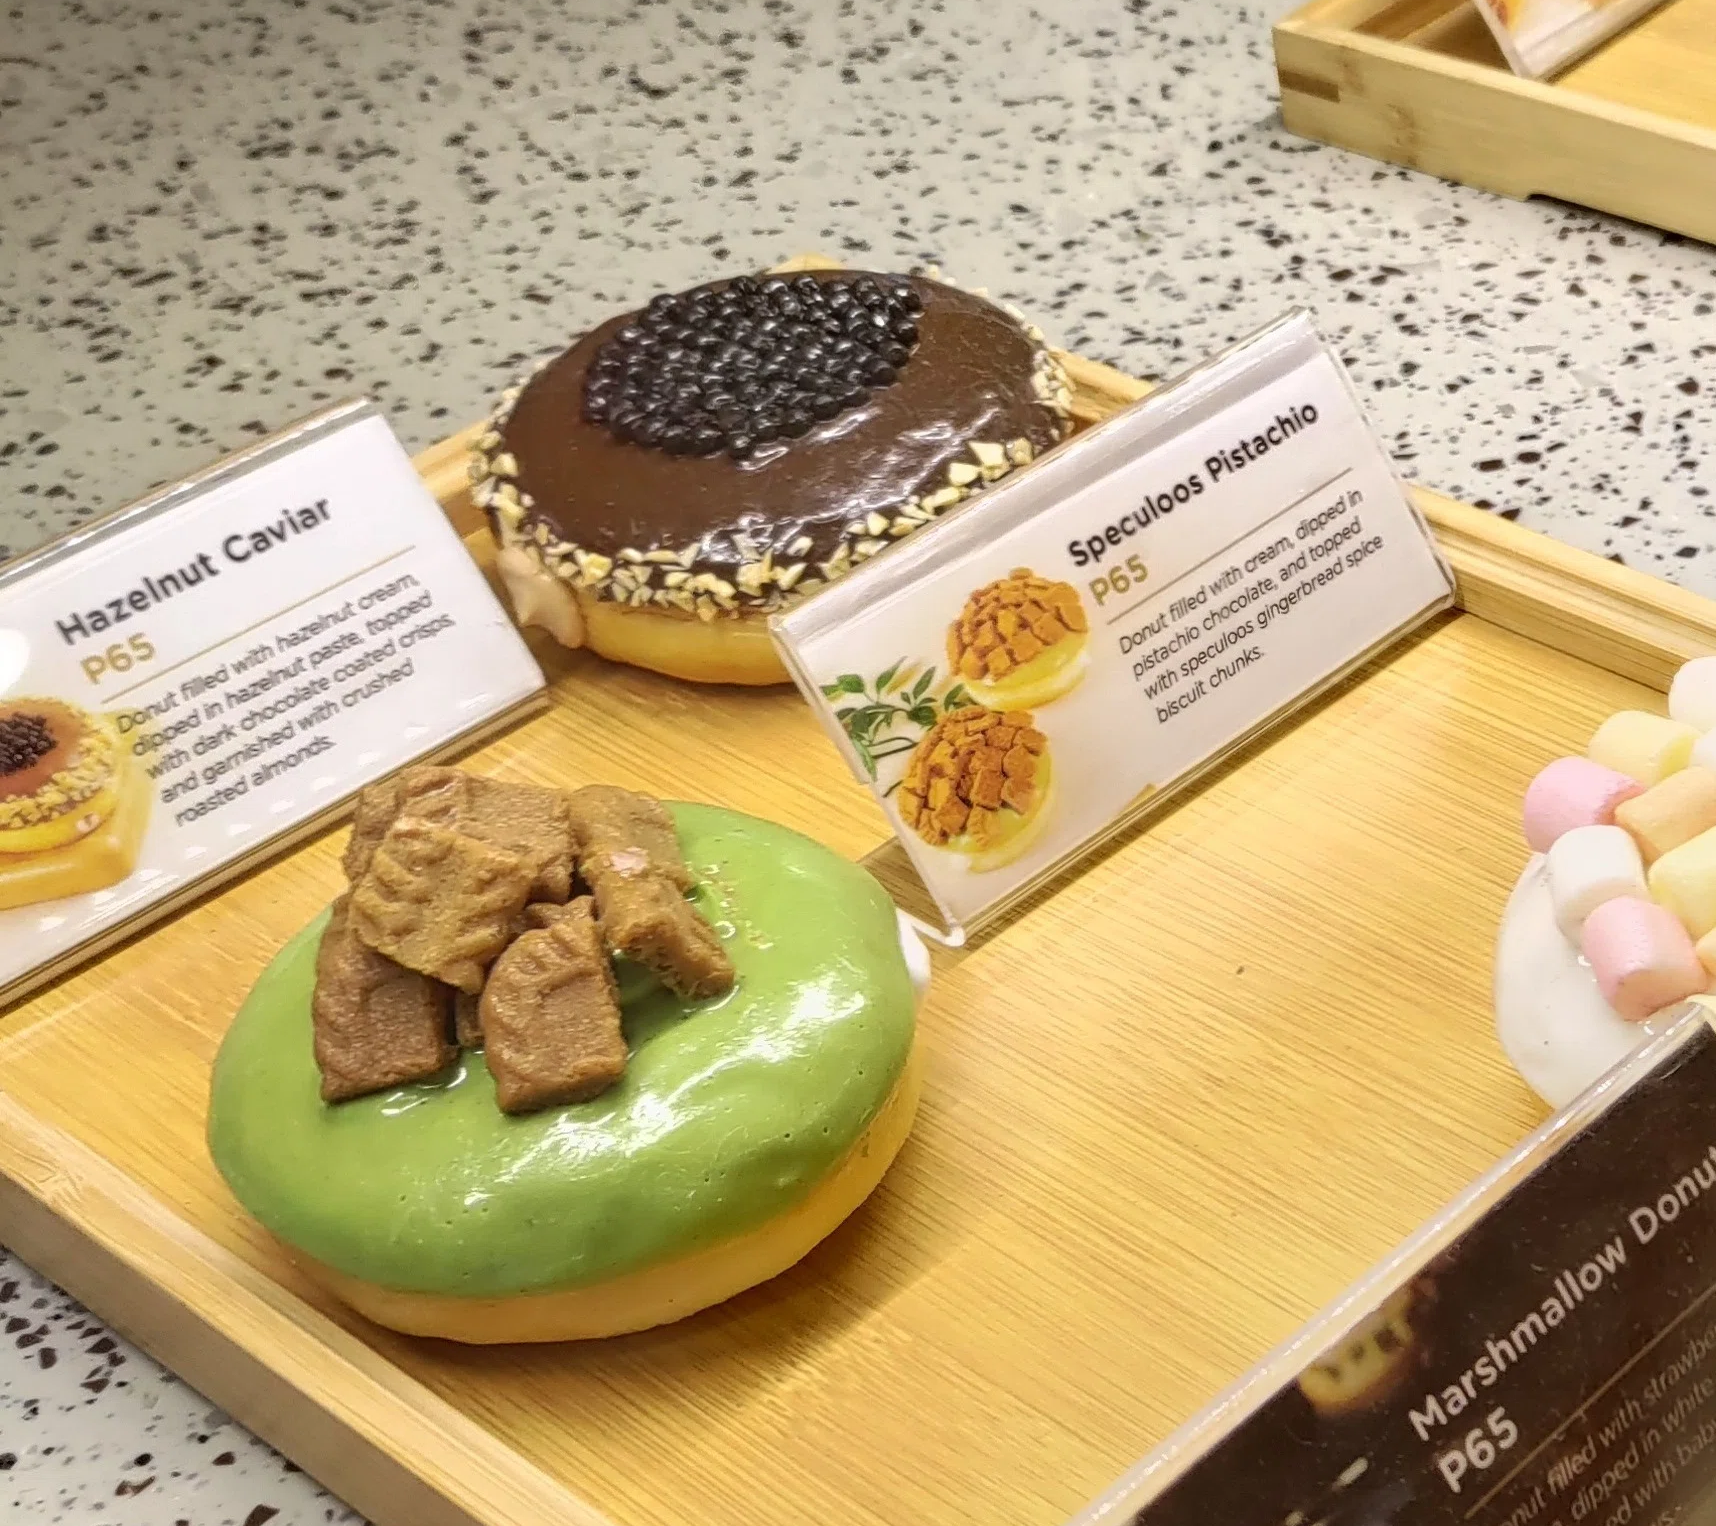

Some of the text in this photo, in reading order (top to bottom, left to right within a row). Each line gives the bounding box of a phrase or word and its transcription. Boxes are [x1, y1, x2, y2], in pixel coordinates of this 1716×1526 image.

[1067, 402, 1319, 567] Speculoos Pistachio
[55, 498, 331, 646] Hazelnut Caviar
[1088, 553, 1149, 607] P65
[1119, 488, 1363, 655] Donut filled with cream, dipped in
[1133, 517, 1362, 680] pistachio chocolate, and topped
[1143, 534, 1384, 700] with speculoos gingerbread spice
[80, 632, 156, 685] P65
[116, 690, 179, 735] Donut
[181, 663, 230, 702] filled
[231, 643, 275, 675] with
[276, 602, 356, 652] hazelnut
[132, 712, 200, 757] dipped
[203, 701, 224, 721] in
[225, 656, 307, 708] hazelnut
[366, 590, 432, 637] topped
[145, 747, 190, 779] with
[193, 725, 239, 758] dark
[239, 675, 330, 731] chocolate
[333, 639, 396, 683] coated
[1156, 645, 1265, 724] biscuit chunks.
[160, 658, 414, 803] and garnished with crushed
[175, 775, 248, 827] roasted
[1408, 1235, 1628, 1442] Marshmallow
[1437, 1407, 1519, 1493] P65
[1546, 1441, 1597, 1495] filled
[1599, 1399, 1642, 1446] with
[1572, 1450, 1640, 1524] dipped
[1640, 1426, 1660, 1458] in
[1662, 1382, 1716, 1438] white
[1633, 1458, 1676, 1506] with
